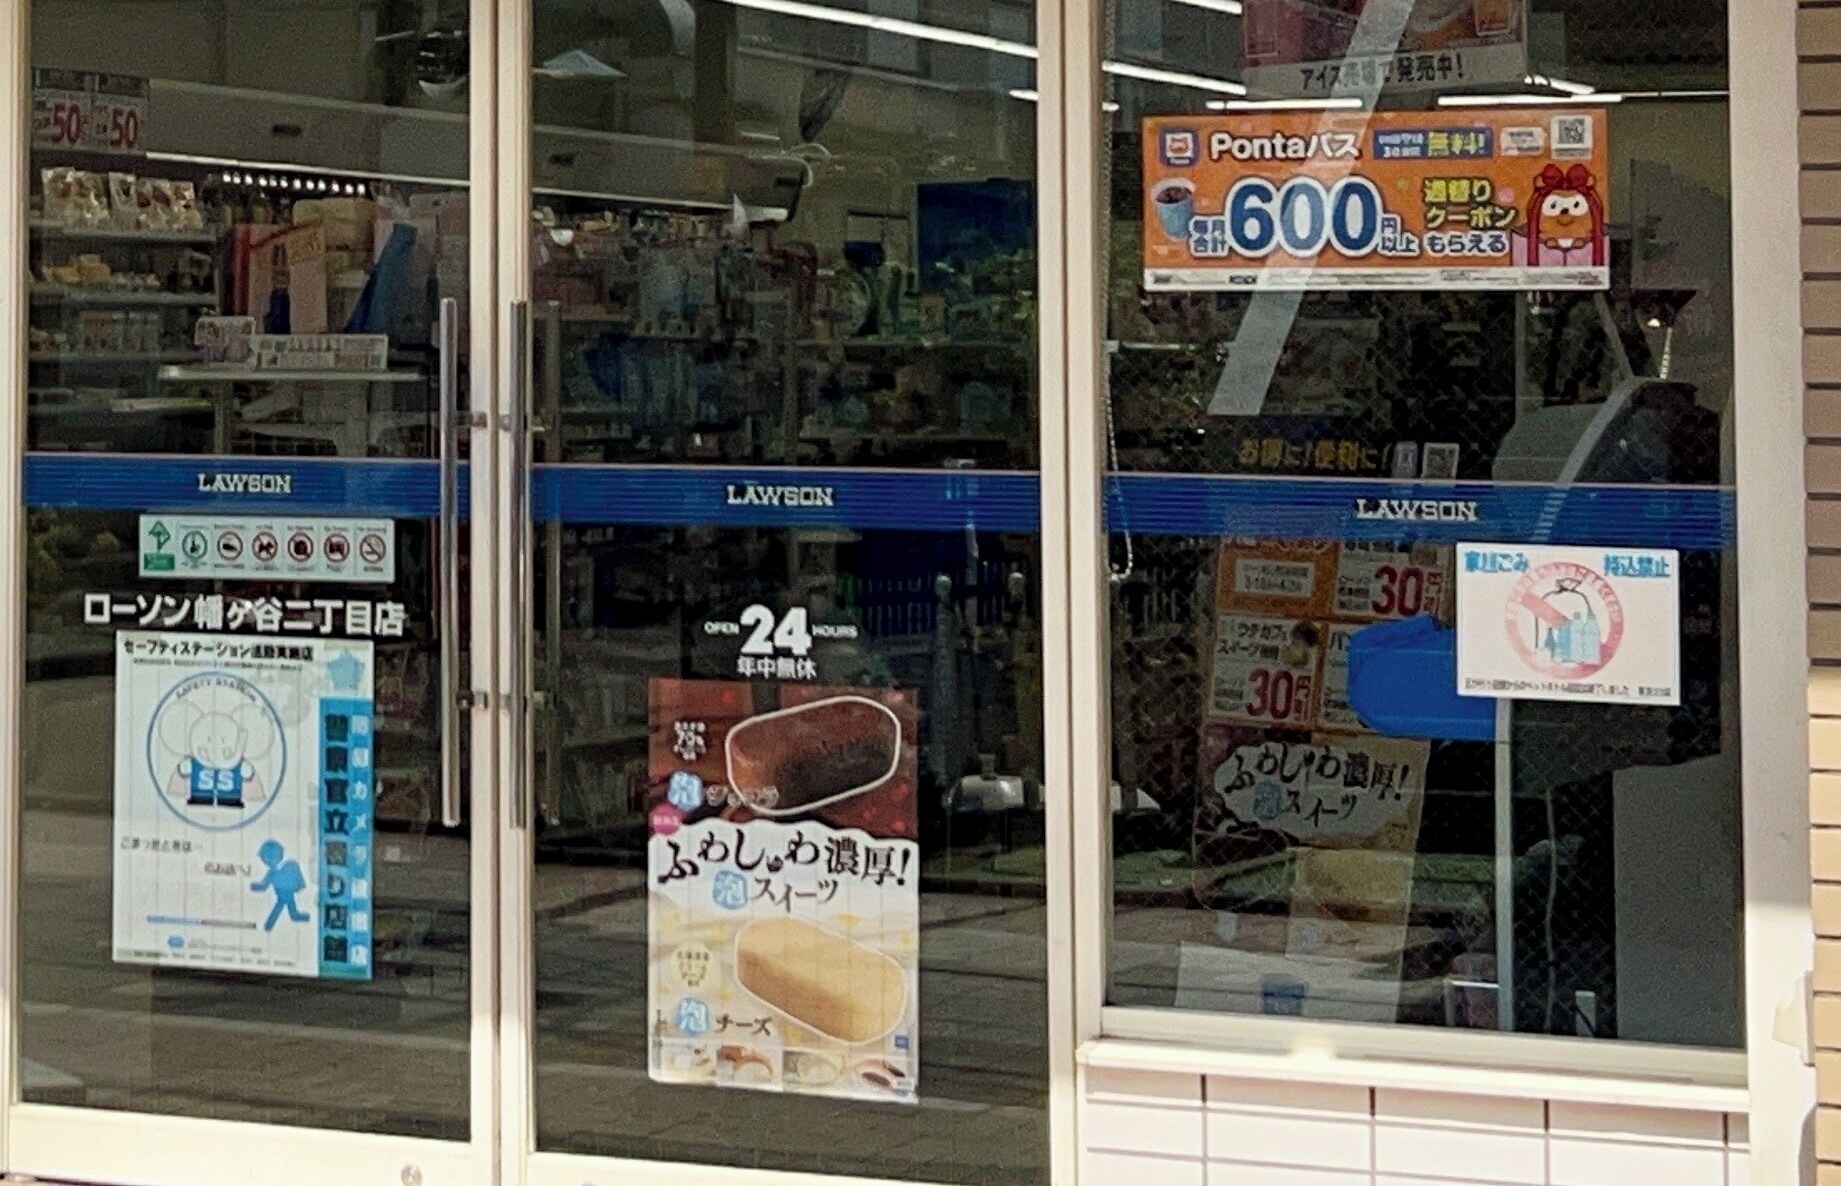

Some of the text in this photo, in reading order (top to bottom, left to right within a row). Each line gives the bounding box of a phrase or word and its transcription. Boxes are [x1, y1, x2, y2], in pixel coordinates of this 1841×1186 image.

[51, 101, 80, 143] 50
[109, 108, 138, 149] 50
[1210, 132, 1360, 161] Pontaパス
[1230, 181, 1378, 252] 600
[1426, 205, 1516, 228] クーポン
[1427, 234, 1507, 253] もらえる
[198, 474, 292, 493] LAWSON
[727, 485, 834, 507] LAWSON
[1357, 498, 1478, 521] LAWSON
[1371, 565, 1425, 617] 30
[704, 604, 858, 656] OPEN 24 HOURS
[737, 656, 817, 680] 年中無休
[1245, 668, 1293, 719] 30
